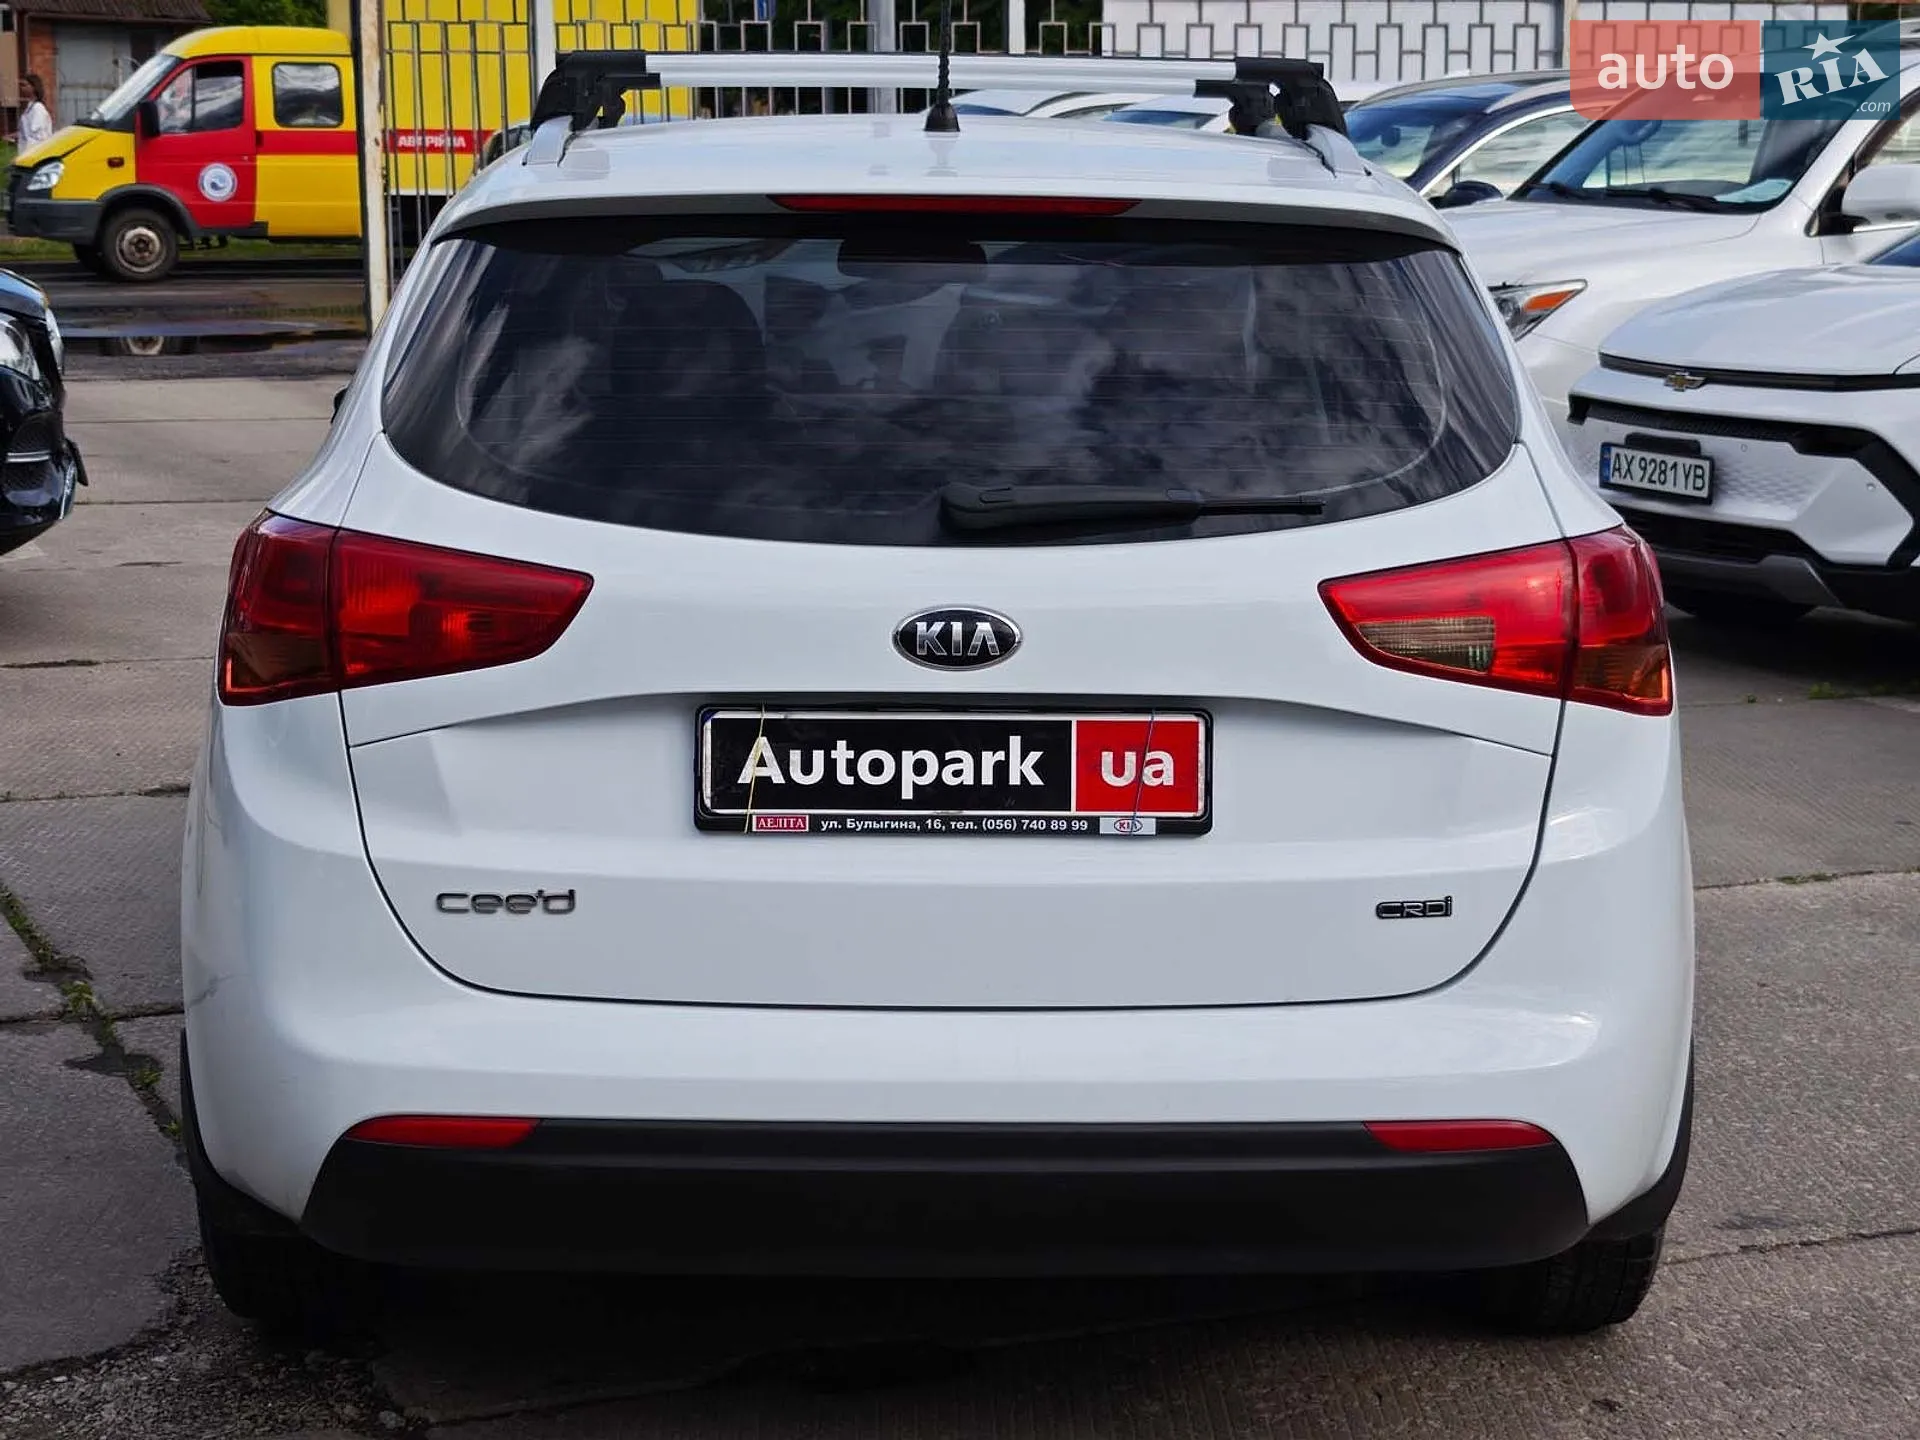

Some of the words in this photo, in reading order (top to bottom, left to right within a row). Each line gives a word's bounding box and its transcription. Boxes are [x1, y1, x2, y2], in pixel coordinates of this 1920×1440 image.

[1611, 452, 1635, 481] AX
[1638, 456, 1679, 488] 9281
[1682, 462, 1706, 492] YB
[915, 621, 1001, 656] KIA
[737, 735, 1045, 800] Autopark
[1100, 748, 1174, 787] ua
[820, 819, 842, 831] ул.
[846, 818, 921, 831] Булыгина,
[925, 818, 945, 831] 16,
[950, 819, 977, 830] тел.
[982, 818, 1017, 831] (056)
[1021, 818, 1046, 830] 740
[1050, 818, 1067, 830] 89
[1071, 818, 1088, 830] 99
[436, 889, 576, 914] cee'd
